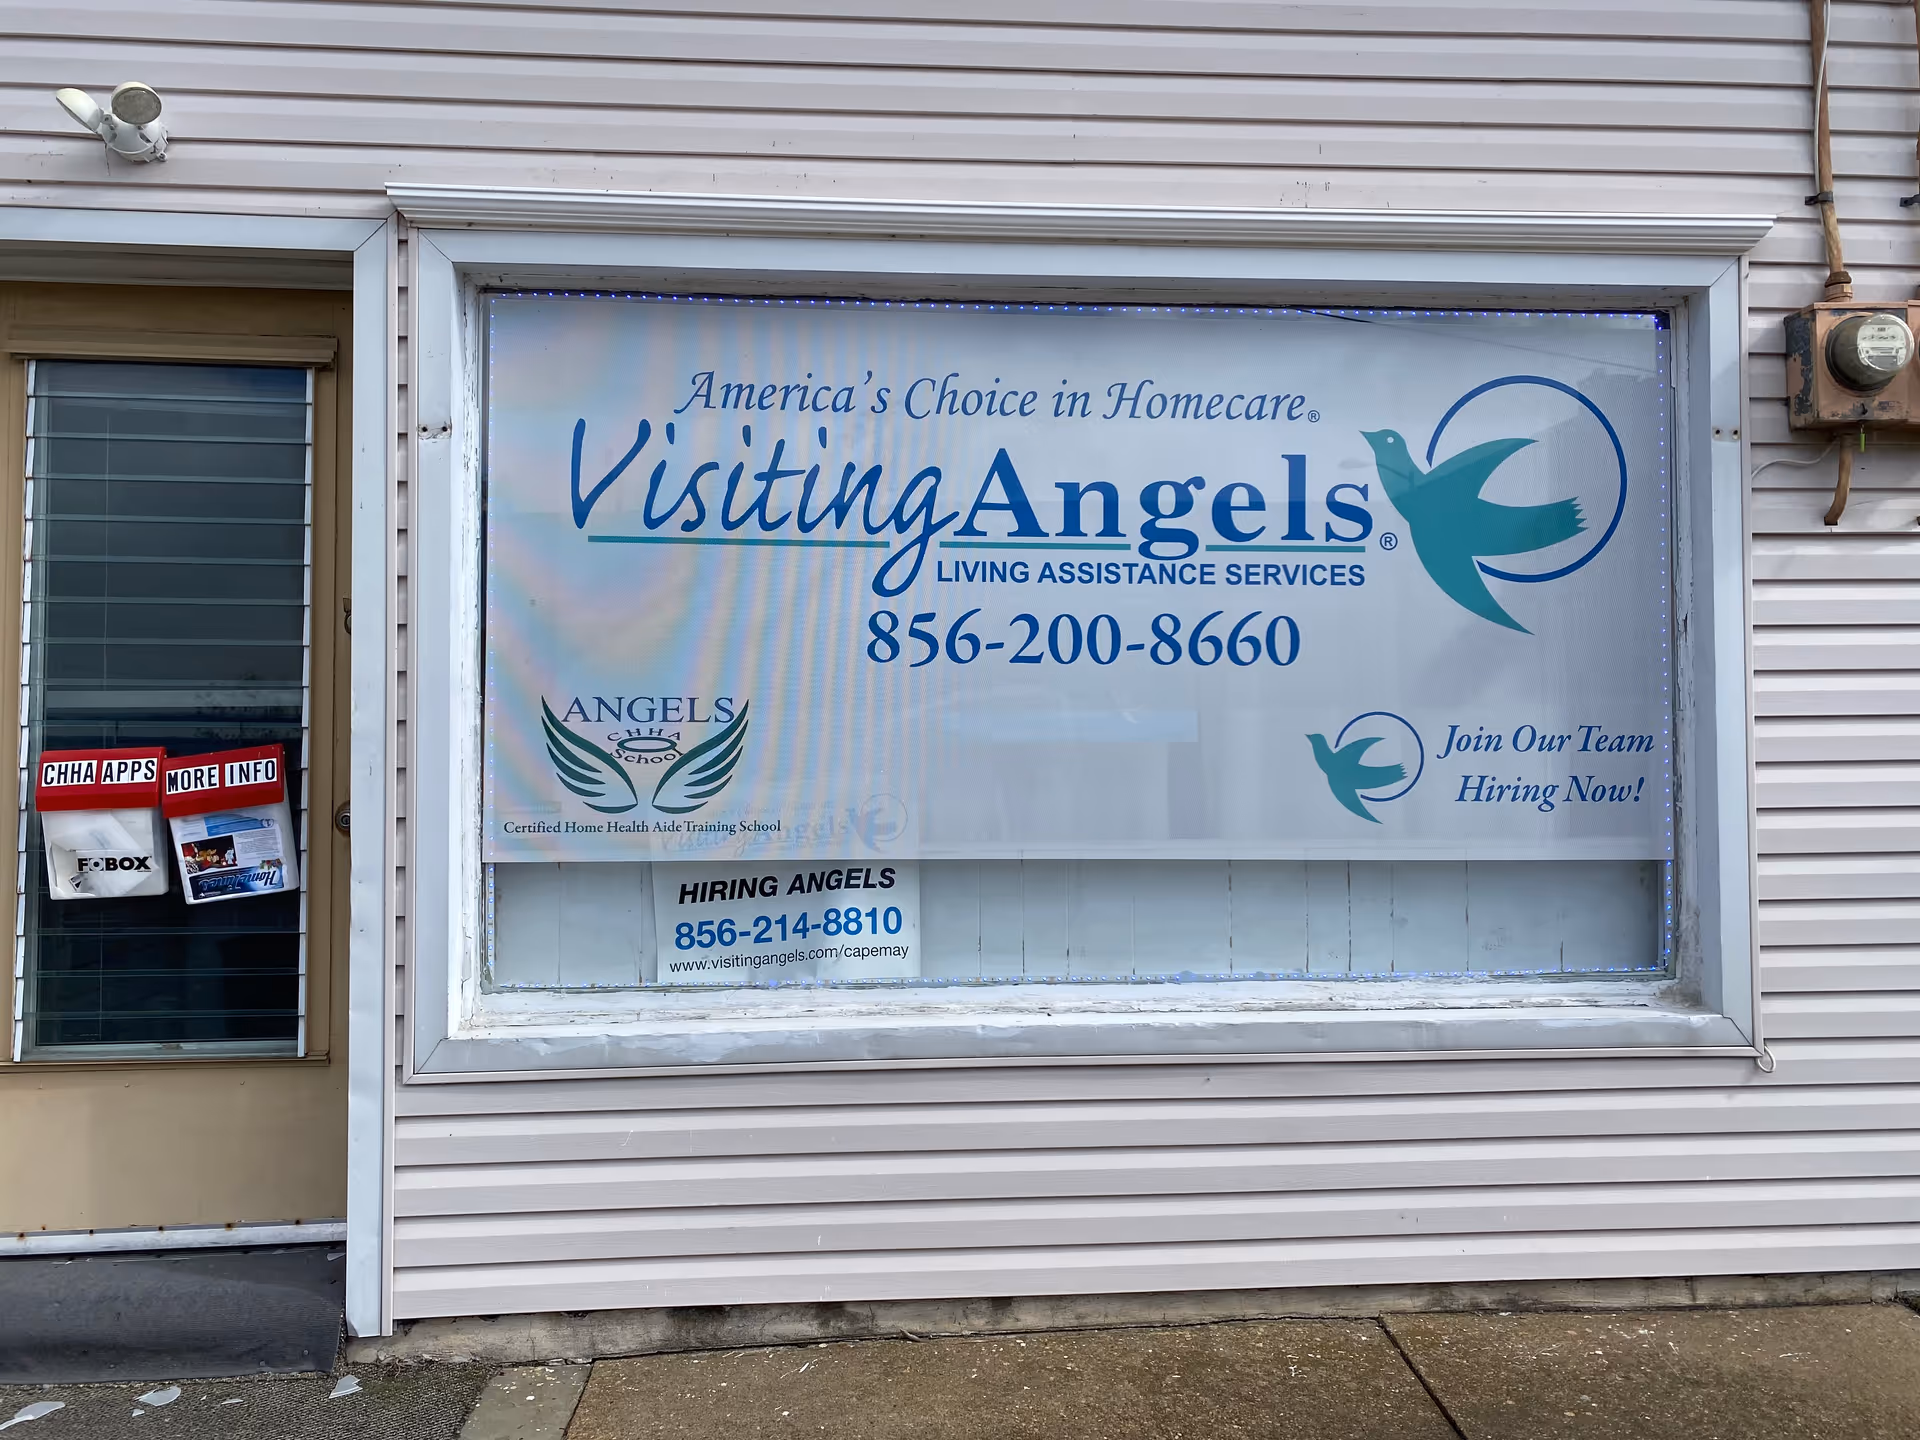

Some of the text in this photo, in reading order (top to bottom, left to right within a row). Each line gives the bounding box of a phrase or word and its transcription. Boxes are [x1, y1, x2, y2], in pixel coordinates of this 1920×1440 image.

[673, 369, 891, 416] America's
[904, 371, 1038, 420] Choice
[1052, 379, 1092, 419] in
[570, 417, 960, 598] Visiting
[936, 560, 1366, 587] LIVING ASSISTANCE SERVICES
[866, 608, 1301, 668] 856-200-8660
[561, 696, 735, 724] ANGELS
[607, 728, 681, 742] CHHA
[1436, 724, 1655, 760] Join Our Team
[43, 759, 156, 786] CHHA APPS
[167, 759, 276, 793] MORE INFO
[1455, 774, 1646, 812] Hiring Now!
[503, 818, 782, 835] Certified Home Health Aide Training School
[677, 867, 897, 905] HIRING ANGELS
[674, 905, 902, 951] 856-214-8810
[669, 943, 910, 973] www.visitingangels.com/capemay
